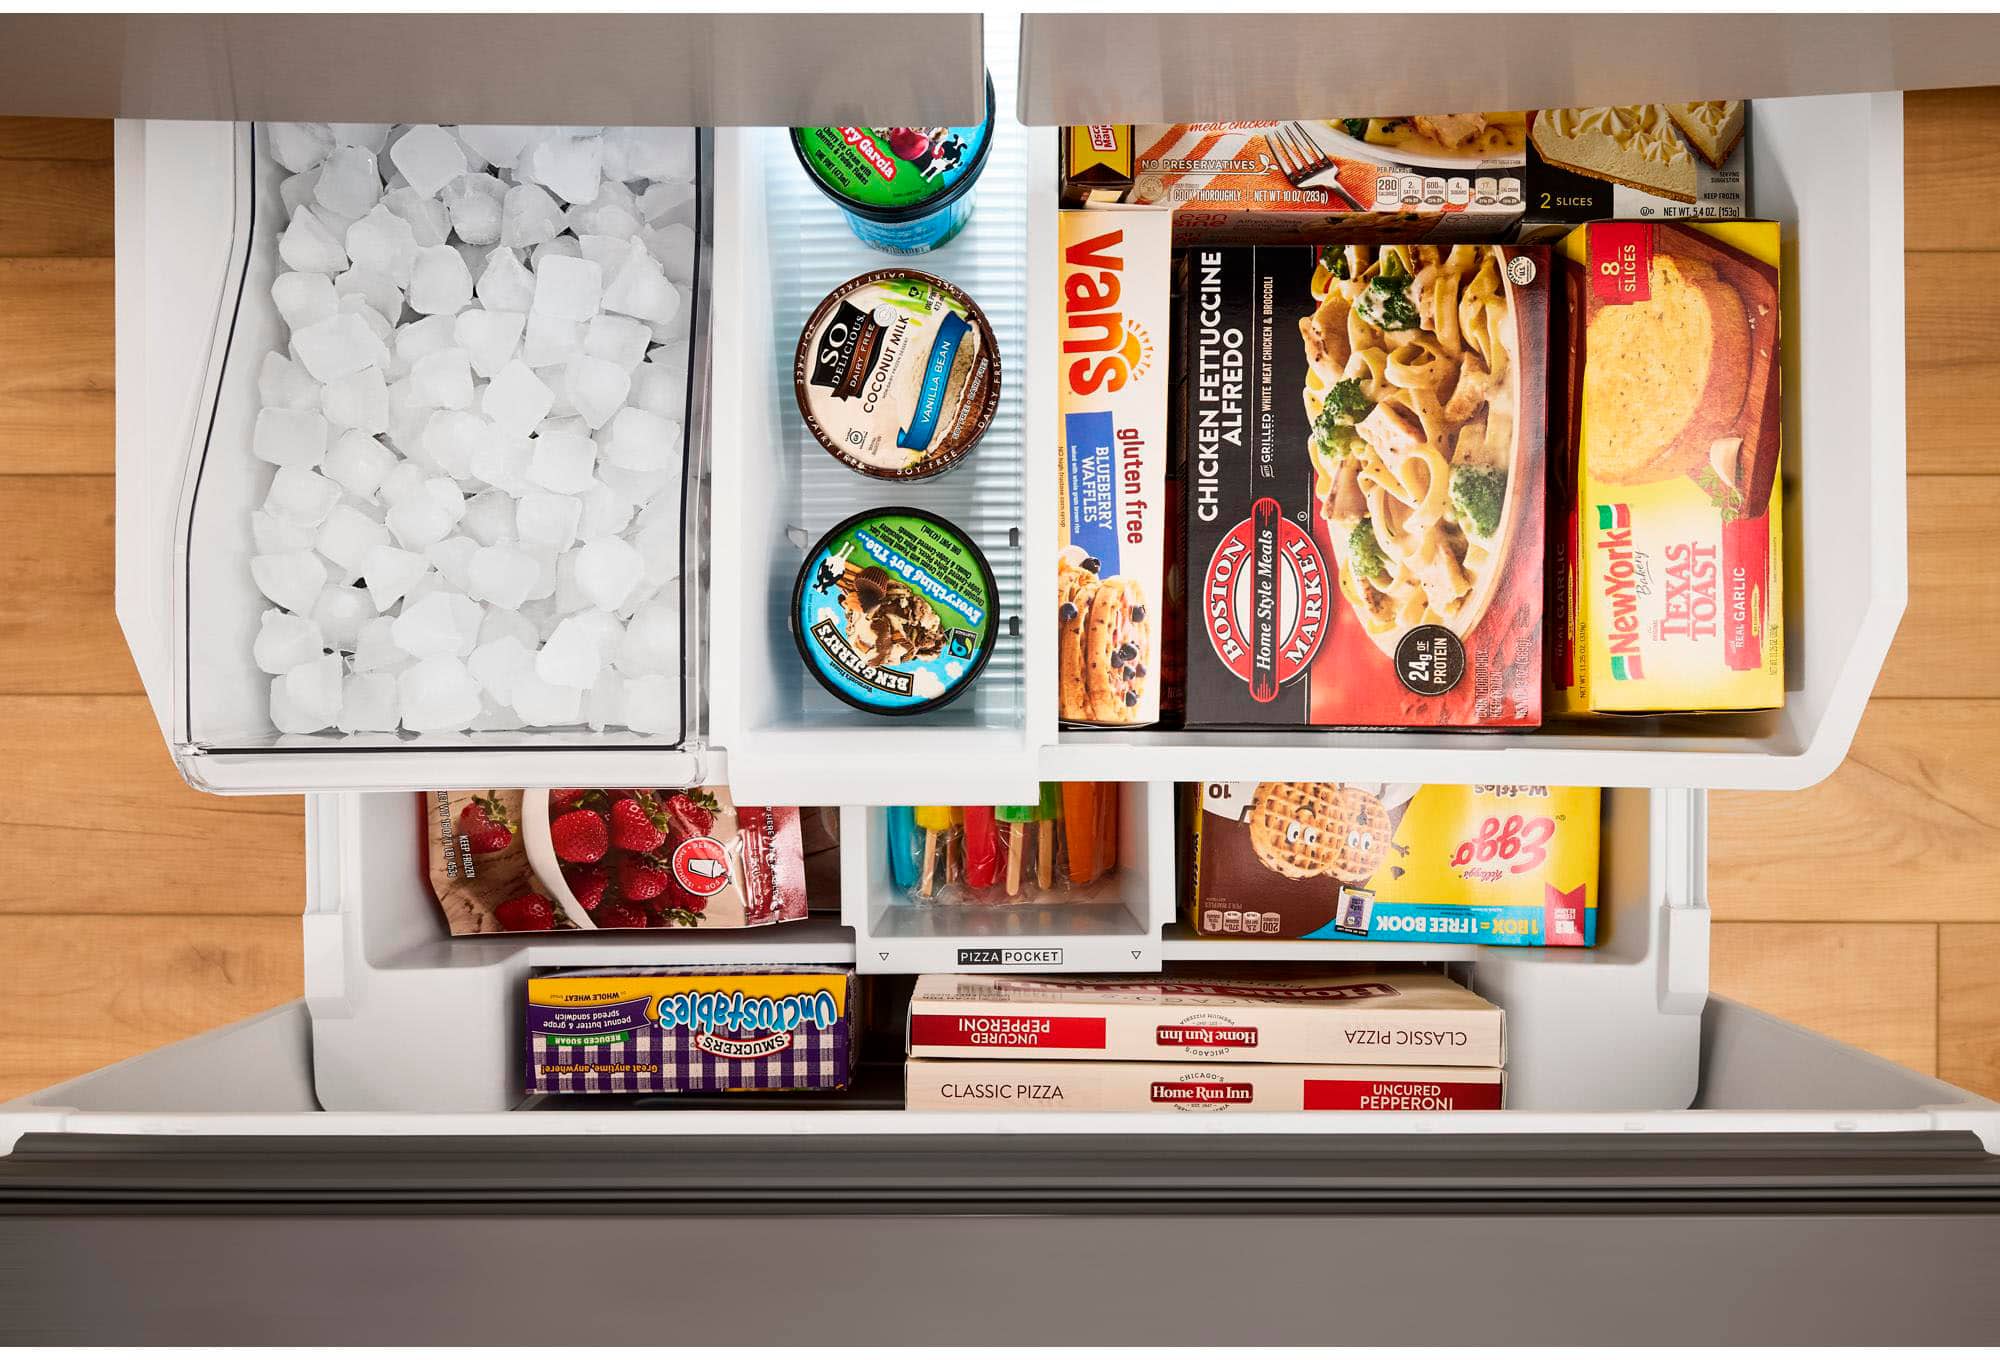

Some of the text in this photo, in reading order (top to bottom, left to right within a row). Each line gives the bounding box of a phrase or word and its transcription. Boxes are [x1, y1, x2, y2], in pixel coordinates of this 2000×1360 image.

[860, 139, 894, 178] Garcia
[1141, 159, 1256, 170] NO PRESERVATIVES
[1378, 179, 1397, 191] 280
[1174, 189, 1193, 201] COOK
[1194, 189, 1242, 201] THOROUGHLY
[1254, 190, 1267, 202] NET
[1268, 190, 1281, 202] WT
[1291, 190, 1301, 202] OZ
[1540, 192, 1593, 209] 2 SLICES
[1663, 207, 1717, 216] NET WT. 5.4 OZ.
[1600, 262, 1620, 276] 8
[1624, 244, 1636, 292] SLICES
[1063, 229, 1128, 396] vans
[820, 322, 848, 367] SO
[832, 315, 864, 385] DELICIOUS
[849, 323, 876, 388] DAIRY FREE
[864, 347, 896, 414] COCONUT
[893, 315, 910, 346] MILK
[1261, 276, 1274, 463] GRILLED WHITE MEAT CHICKEN & BROCCOLI
[921, 341, 951, 423] VANILLA BEAN
[1198, 252, 1222, 522] CHICKEN FETTUCCINE
[1222, 328, 1244, 447] ALFREDO
[979, 390, 998, 429] DAIRY
[952, 422, 964, 439] SOY
[958, 404, 971, 424] FREE
[1082, 456, 1097, 523] WAFFLES
[1096, 446, 1112, 530] BLUEBERRY
[1116, 428, 1147, 544] gluten free
[858, 533, 982, 624] Everything But The...
[1556, 543, 1565, 619] GARLIC
[1211, 536, 1246, 664] BOSTON
[1256, 529, 1276, 671] Home Style Meals
[1660, 543, 1691, 641] TEXAS
[1691, 541, 1717, 642] TOAST
[1285, 536, 1322, 666] MARKET
[1733, 567, 1745, 649] REAL GARLIC
[817, 624, 909, 692] BEN & JERRY'S
[1409, 641, 1433, 682] 24g OF
[1434, 637, 1448, 684] PROTEIN
[1209, 784, 1232, 799] 10
[766, 814, 775, 836] HERE
[1451, 814, 1555, 874] Eggo
[460, 834, 476, 878] KEEP FROZEN
[1464, 867, 1503, 882] Kellogg's
[1263, 922, 1279, 932] 200
[1376, 915, 1426, 932] BOOK
[1430, 917, 1468, 933] FREE
[1472, 917, 1478, 933] 1
[1492, 919, 1530, 934] BOX
[1532, 918, 1538, 934] 1
[960, 951, 1059, 962] PIZZA POCKET
[593, 992, 620, 1001] WHOLE
[555, 1009, 620, 1021] spread sandwich
[658, 991, 837, 1035] Uncrustables
[543, 1020, 567, 1029] grape
[576, 1020, 602, 1029] butter
[604, 1016, 631, 1028] peanut
[958, 1018, 1050, 1033] PEPPERONI
[555, 1034, 621, 1045] REDUCED SUGAR
[970, 1033, 1038, 1045] UNCURED
[1160, 1028, 1256, 1044] Home Run Inn
[1345, 1030, 1467, 1046] CLASSIC PIZZA
[703, 1035, 785, 1055] SMUCKER'S
[1185, 1047, 1230, 1056] CHICAGO'S
[541, 1064, 658, 1074] Great anytime, anywhere!
[1180, 1072, 1224, 1082] CHICAGO'S
[941, 1084, 1064, 1099] CLASSIC PIZZA
[1153, 1086, 1250, 1100] Home Run Inn
[1373, 1084, 1441, 1096] UNCURED
[1360, 1096, 1453, 1110] PEPPERONI
